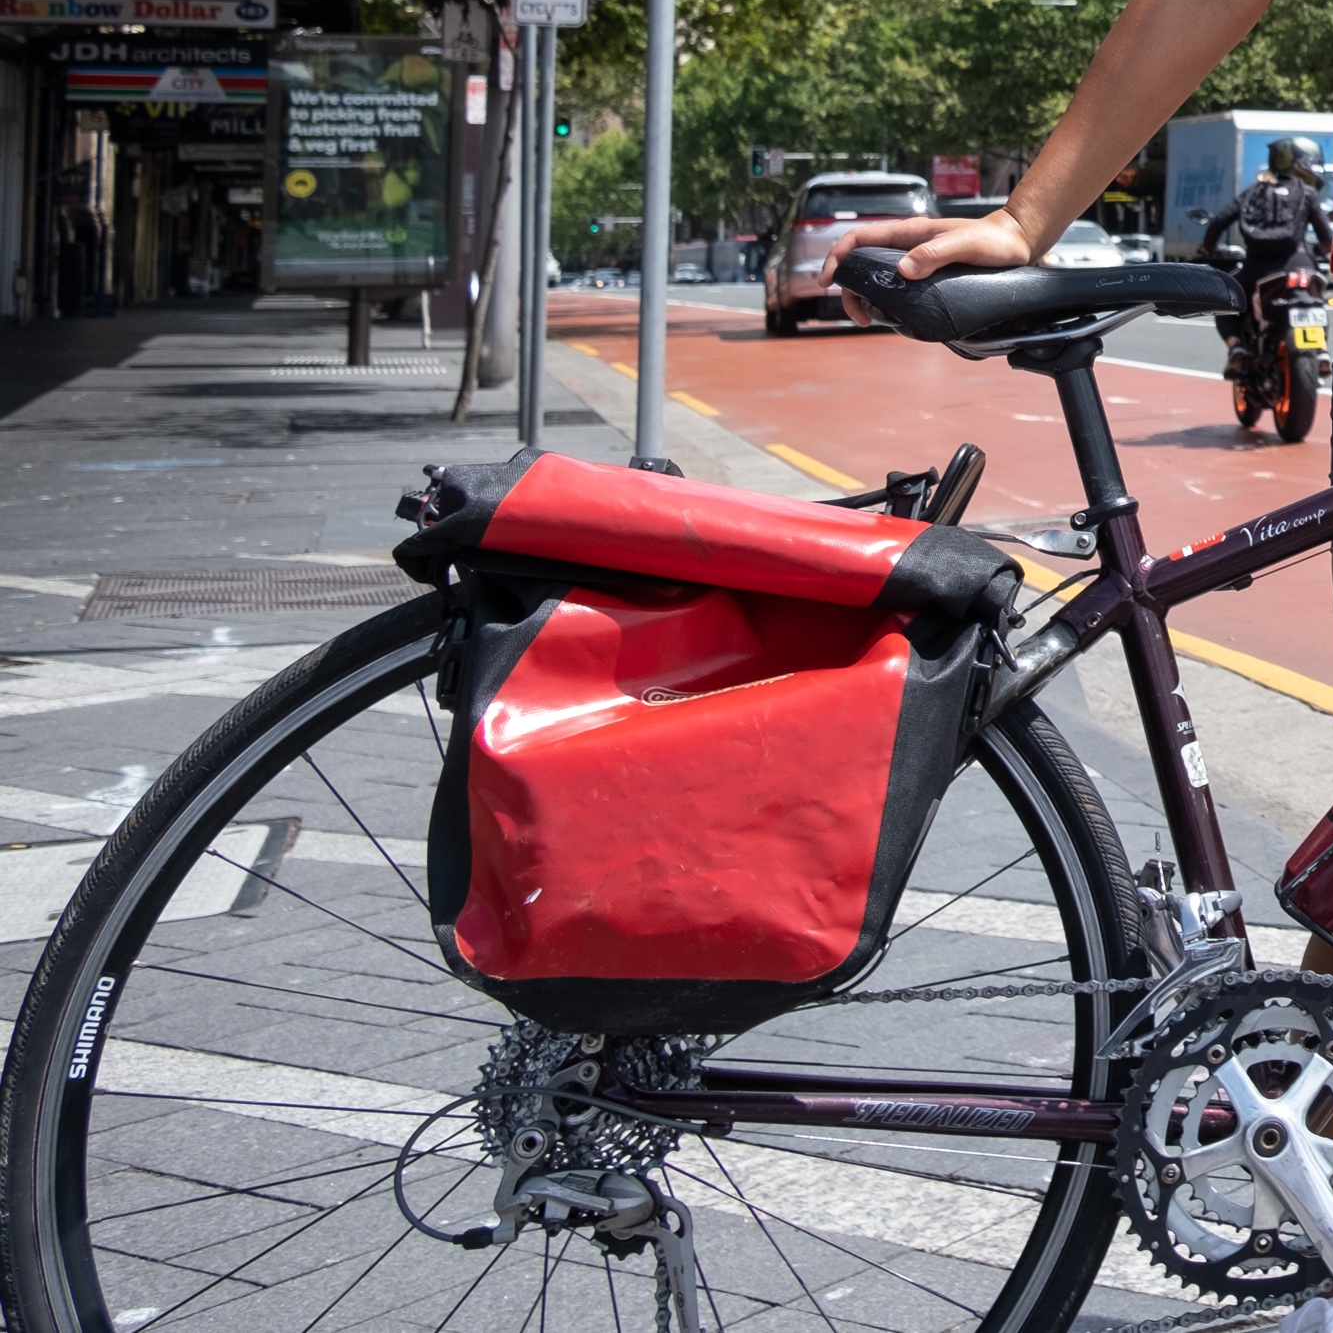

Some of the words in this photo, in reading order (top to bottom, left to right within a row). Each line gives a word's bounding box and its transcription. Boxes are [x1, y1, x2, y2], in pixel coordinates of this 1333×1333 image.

[50, 42, 128, 62] JDH
[132, 44, 252, 64] architects
[290, 90, 341, 106] We're
[342, 90, 439, 107] committed
[143, 100, 198, 119] VIP
[289, 106, 310, 122] to
[311, 107, 375, 125] picking
[377, 107, 422, 122] fresh
[288, 122, 381, 138] Australian
[383, 122, 421, 138] fruit
[339, 137, 378, 153] first
[1302, 329, 1317, 343] L
[1240, 515, 1292, 547] Vita
[1292, 508, 1327, 524] comp
[69, 976, 116, 1079] SHIMANO
[843, 1099, 1036, 1133] SPECIALIZED
